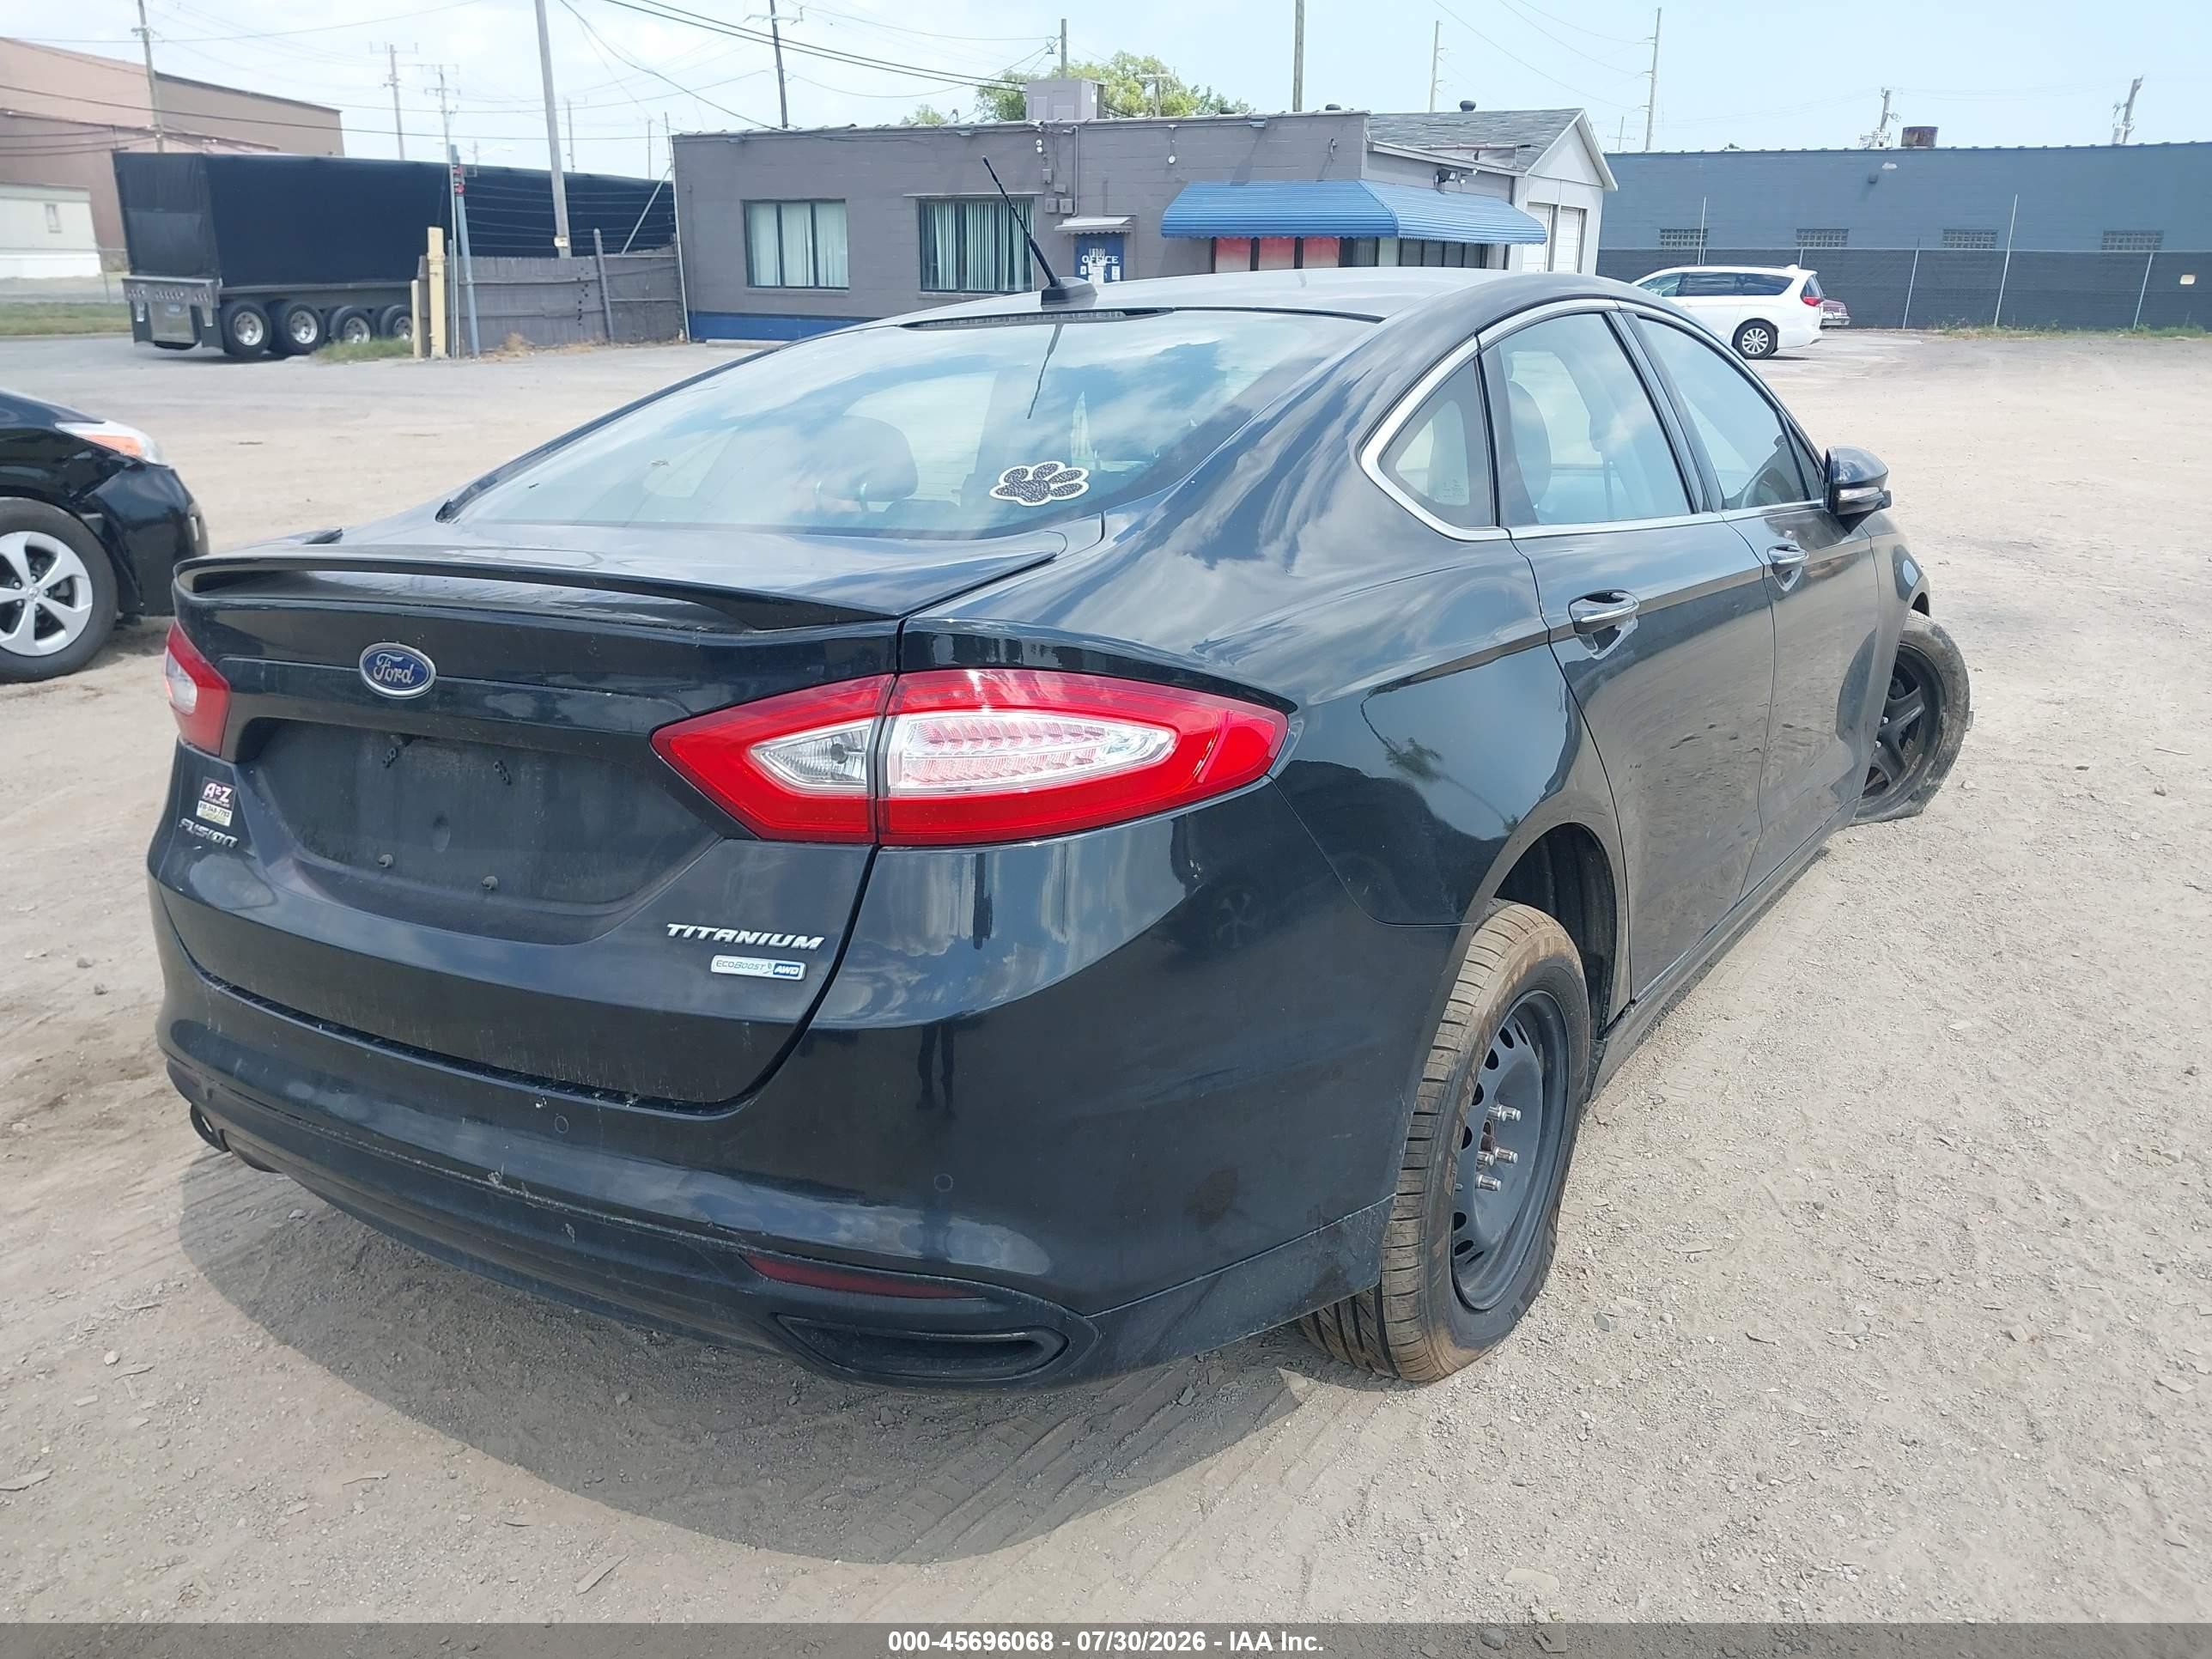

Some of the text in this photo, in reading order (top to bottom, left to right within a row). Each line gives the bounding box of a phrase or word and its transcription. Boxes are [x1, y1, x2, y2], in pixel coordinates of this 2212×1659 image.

[373, 653, 415, 684] Ford
[178, 817, 239, 848] FUSION
[666, 923, 825, 950] TITANIUM
[774, 964, 799, 975] AWD
